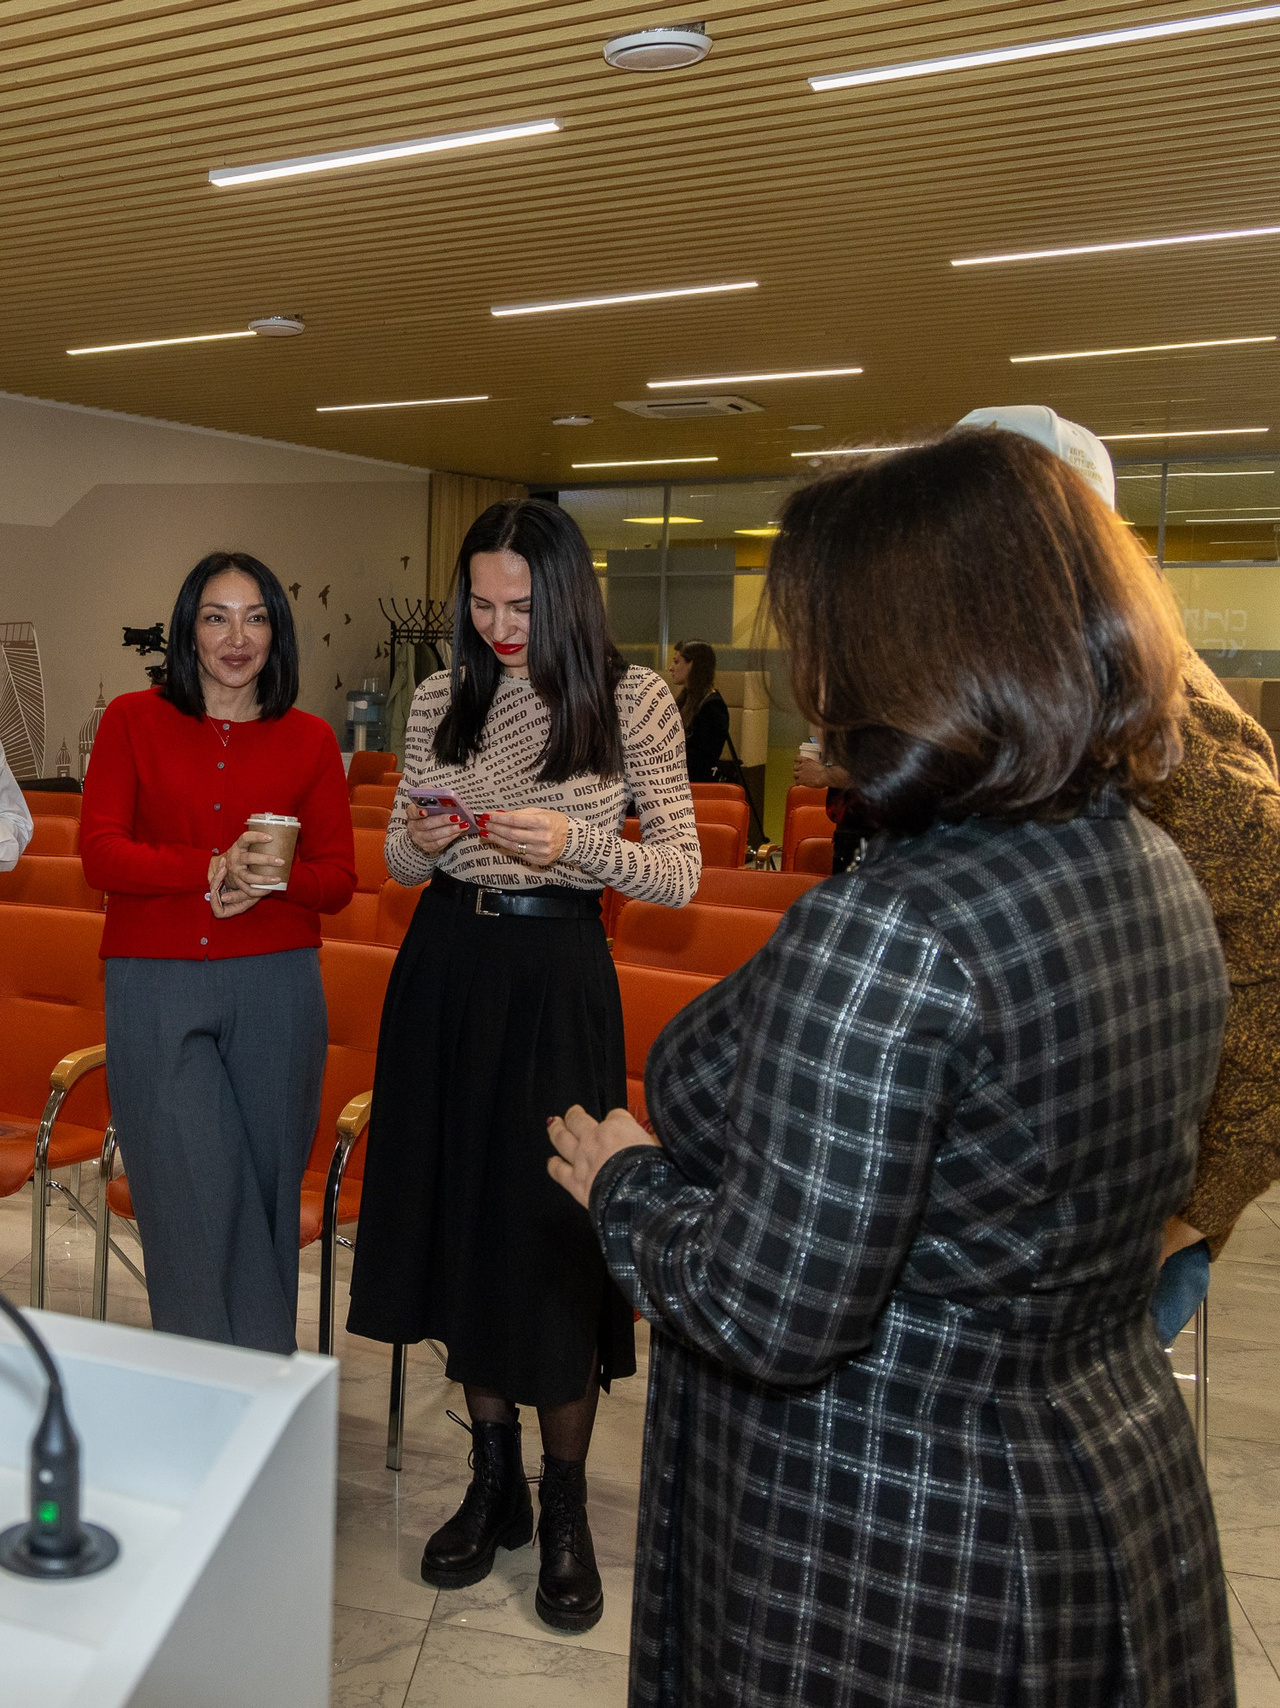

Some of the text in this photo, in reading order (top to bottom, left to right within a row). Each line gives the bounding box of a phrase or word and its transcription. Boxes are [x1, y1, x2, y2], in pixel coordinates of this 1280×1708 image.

[454, 763, 476, 776] NOT
[480, 735, 533, 764] ALLOWED
[630, 749, 674, 769] ALLOWED
[468, 776, 490, 787] NOT
[648, 773, 683, 786] ALLOWED
[508, 792, 564, 807] ALLOWED
[600, 794, 613, 806] NOT
[640, 800, 661, 812] NOT
[476, 856, 491, 867] NOT
[524, 874, 543, 885] NOT
